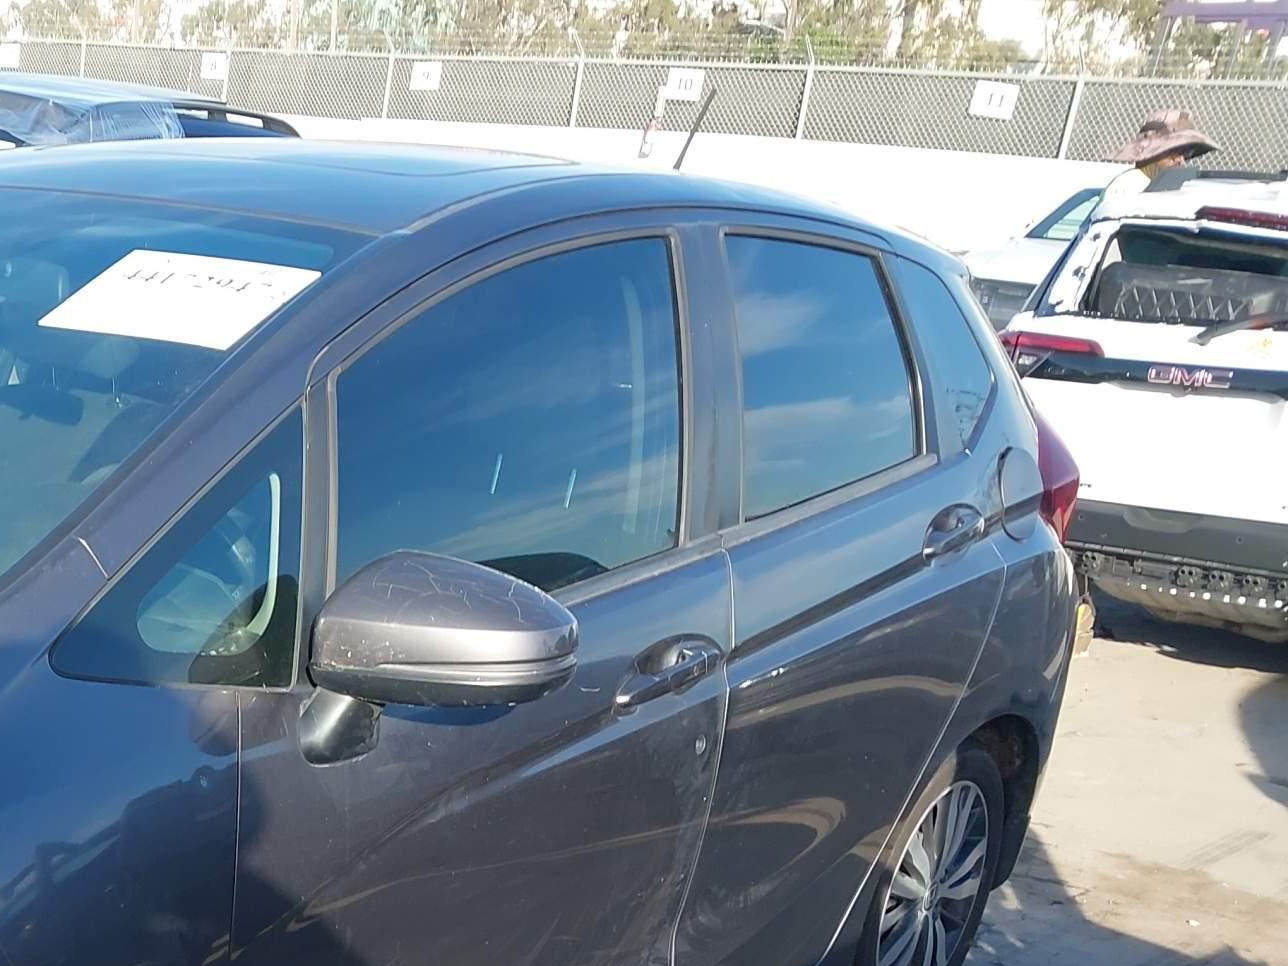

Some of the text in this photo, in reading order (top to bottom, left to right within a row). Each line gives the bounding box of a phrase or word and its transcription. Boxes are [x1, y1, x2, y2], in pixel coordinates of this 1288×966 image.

[677, 77, 693, 91] 10
[987, 92, 1005, 108] 11
[1147, 366, 1234, 389] GMC
